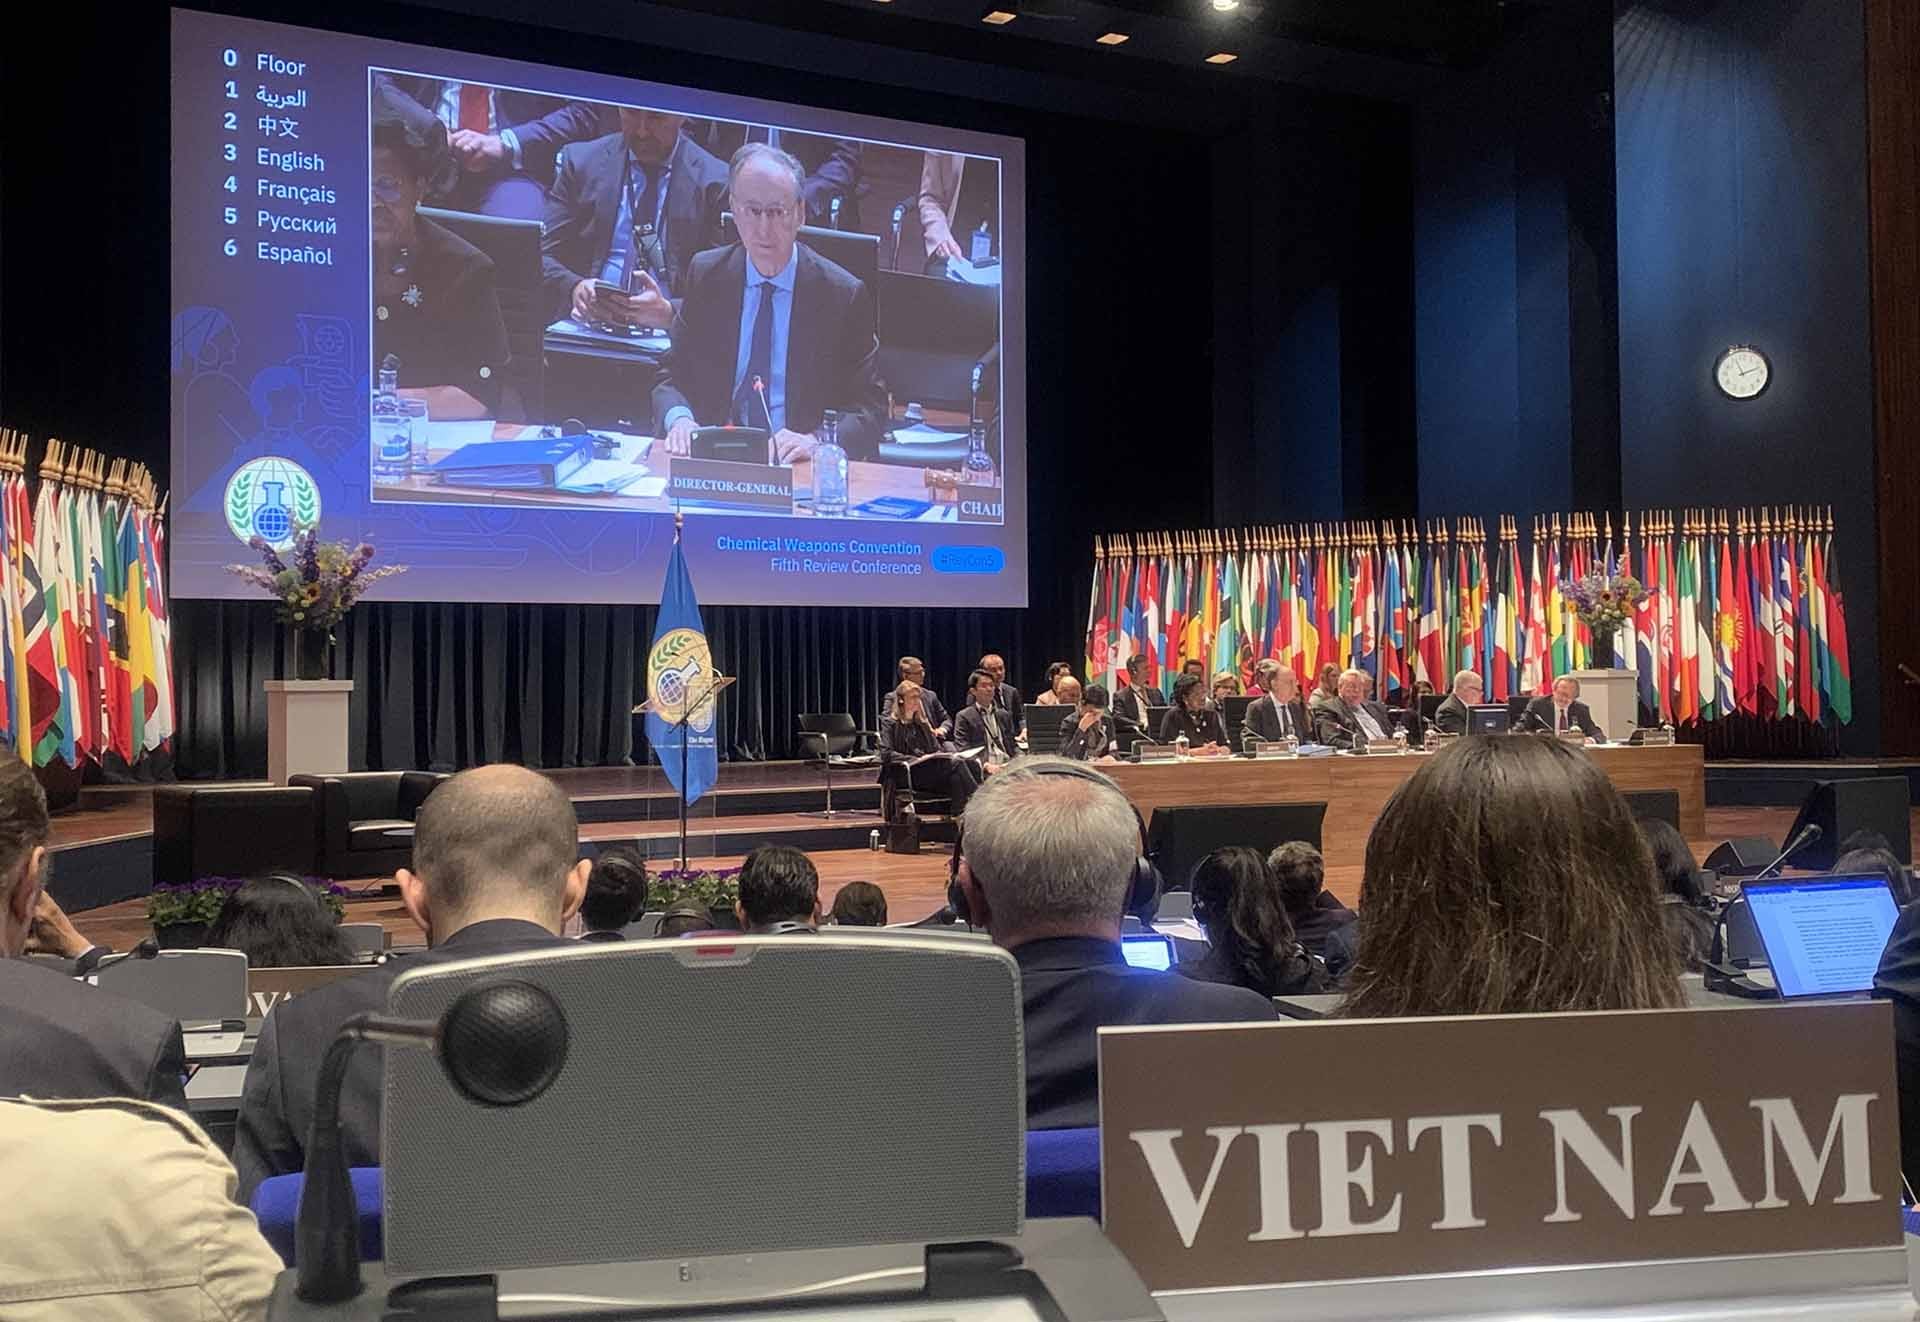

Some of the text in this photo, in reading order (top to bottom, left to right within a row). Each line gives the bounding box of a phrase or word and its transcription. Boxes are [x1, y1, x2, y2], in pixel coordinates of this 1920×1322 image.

[223, 49, 306, 76] 0 Floor
[225, 80, 306, 109] 1 العربية
[224, 112, 299, 139] 2 中文
[224, 144, 325, 172] 3 English
[224, 176, 336, 205] 4 Français
[224, 207, 337, 234] 5 Русский
[224, 239, 333, 265] 6 Español
[673, 477, 792, 497] DIRECTOR-GENERAL
[717, 536, 921, 555] Chemical Weapons Convention
[771, 558, 921, 575] Fifth Review Conference
[1129, 1093, 1882, 1249] VIET NAM
